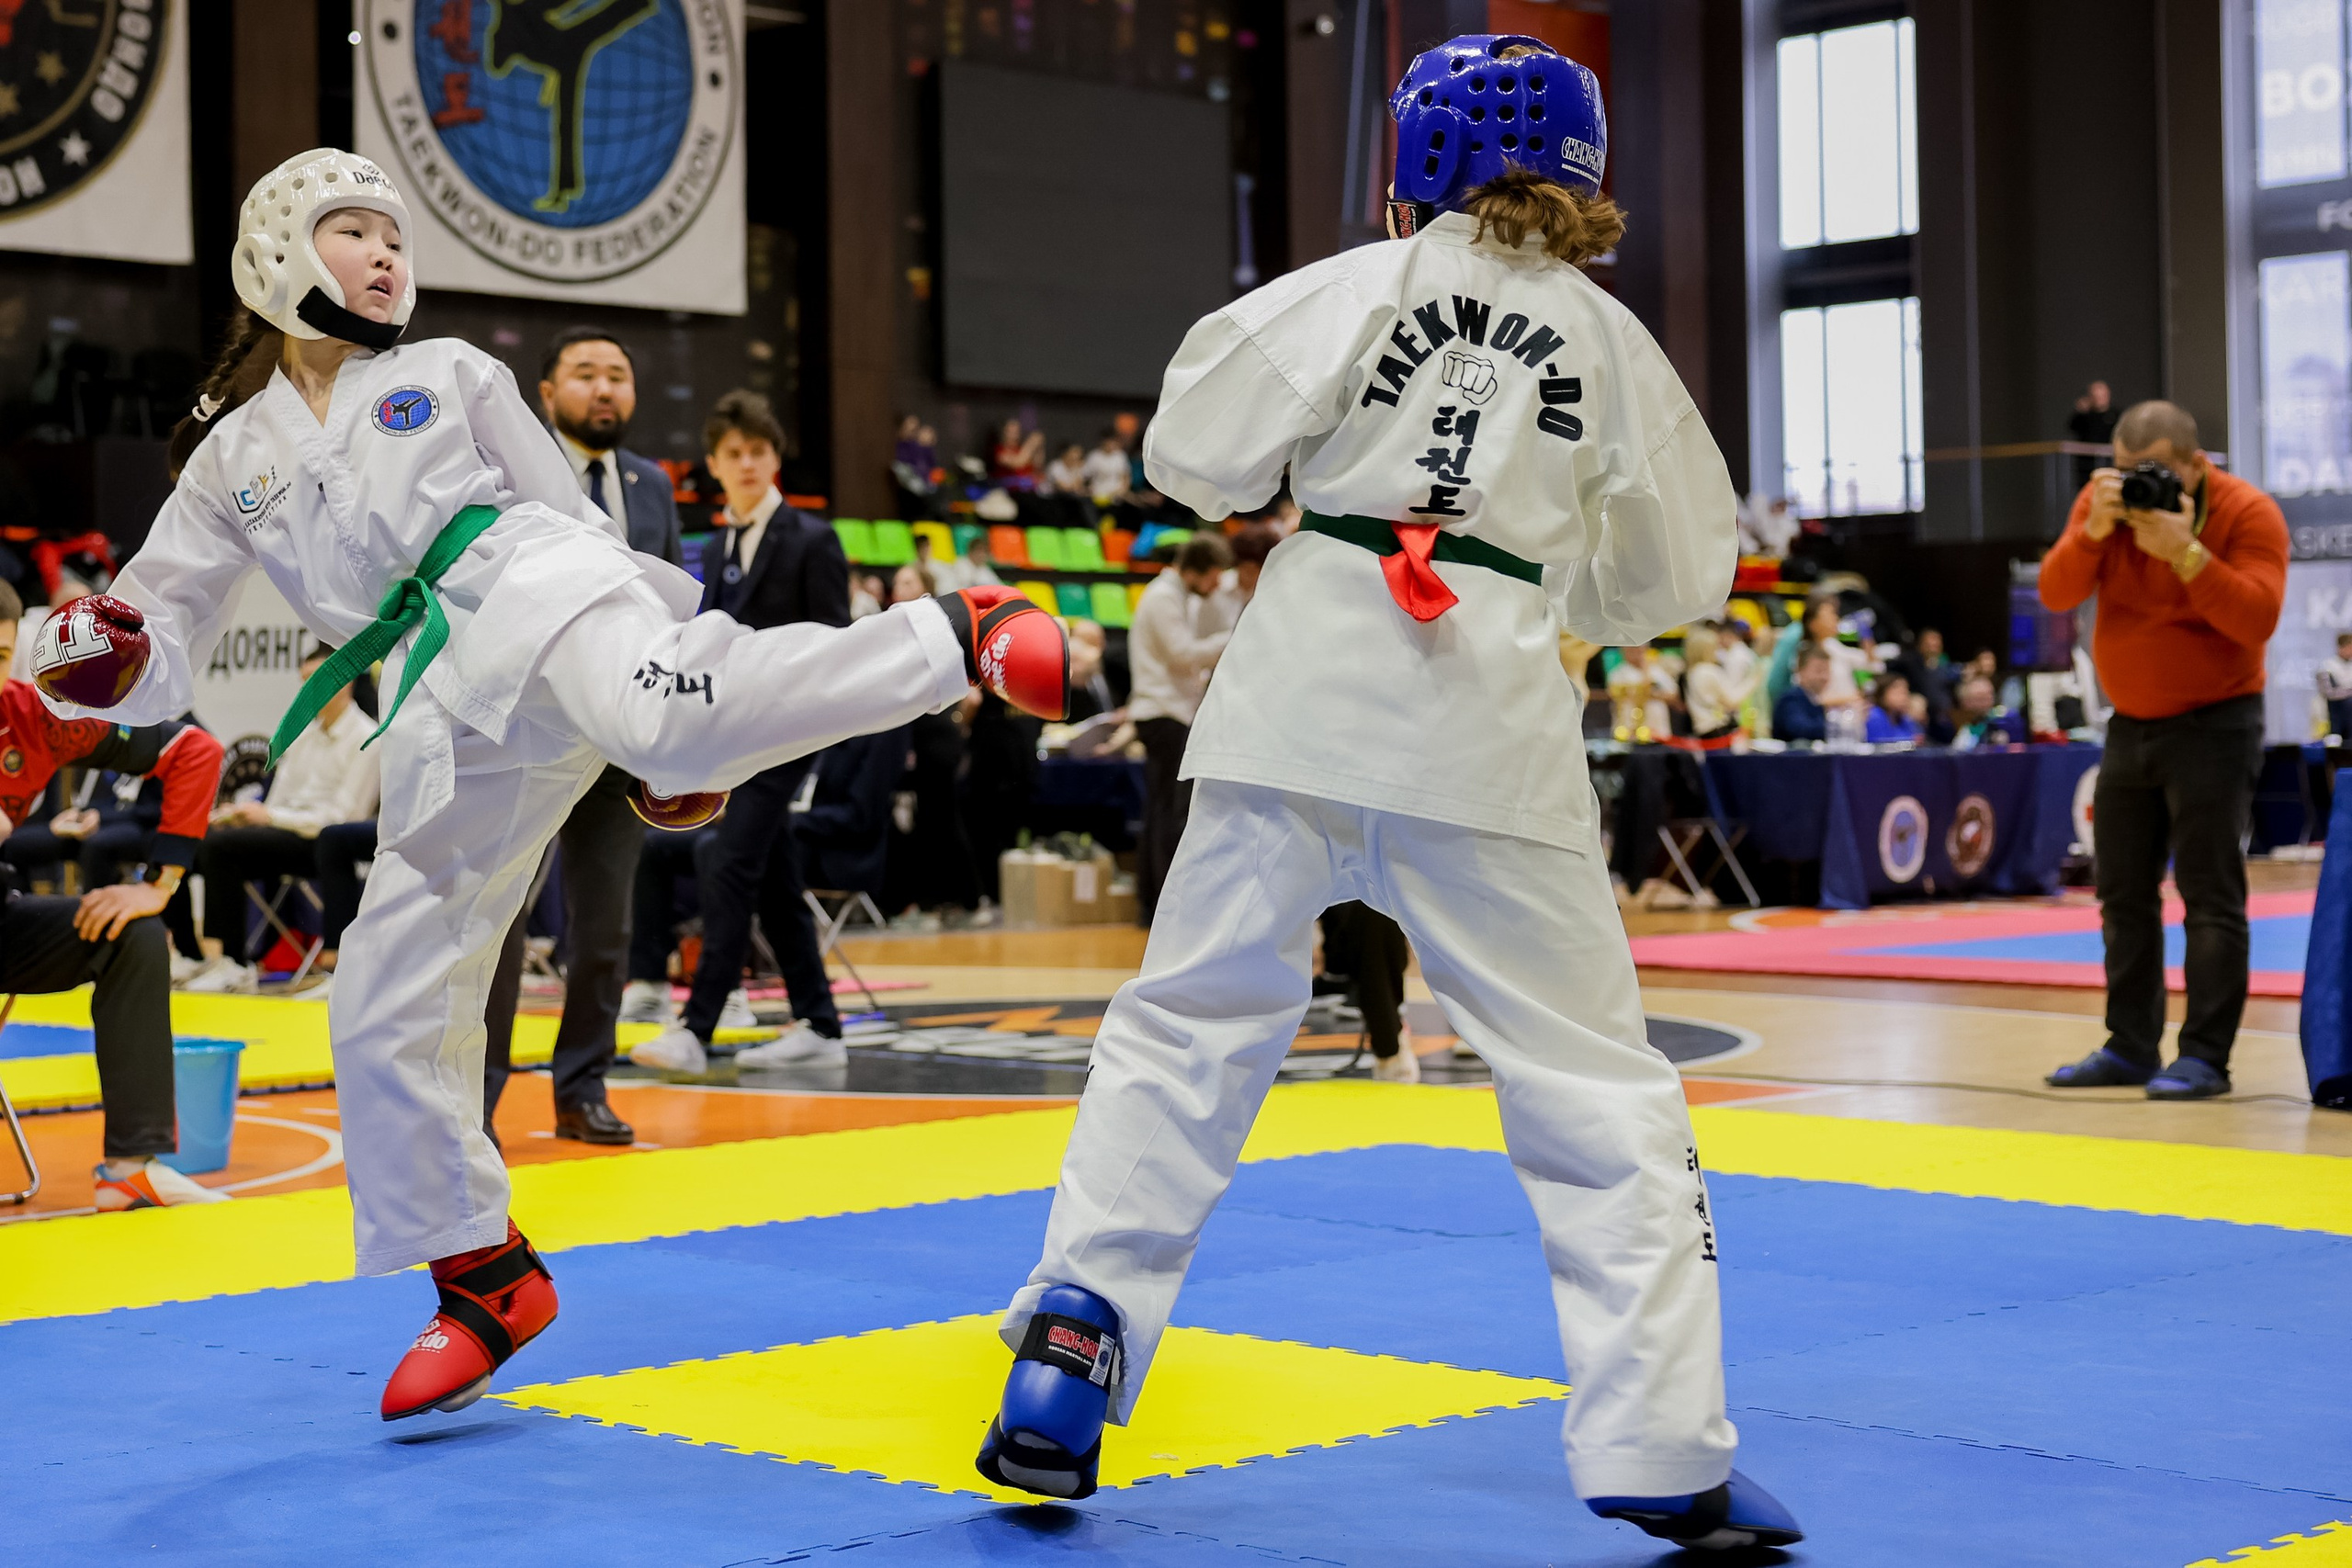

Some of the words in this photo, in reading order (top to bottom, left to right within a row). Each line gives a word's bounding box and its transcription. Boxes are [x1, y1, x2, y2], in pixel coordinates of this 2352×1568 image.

[2262, 62, 2352, 118] BO
[395, 93, 564, 265] TAEKWON-DO
[572, 125, 717, 265] FEDERATION
[1361, 294, 1583, 441] TAEKWON-DO
[1408, 406, 1480, 516] 태권도
[2277, 458, 2352, 498] DA
